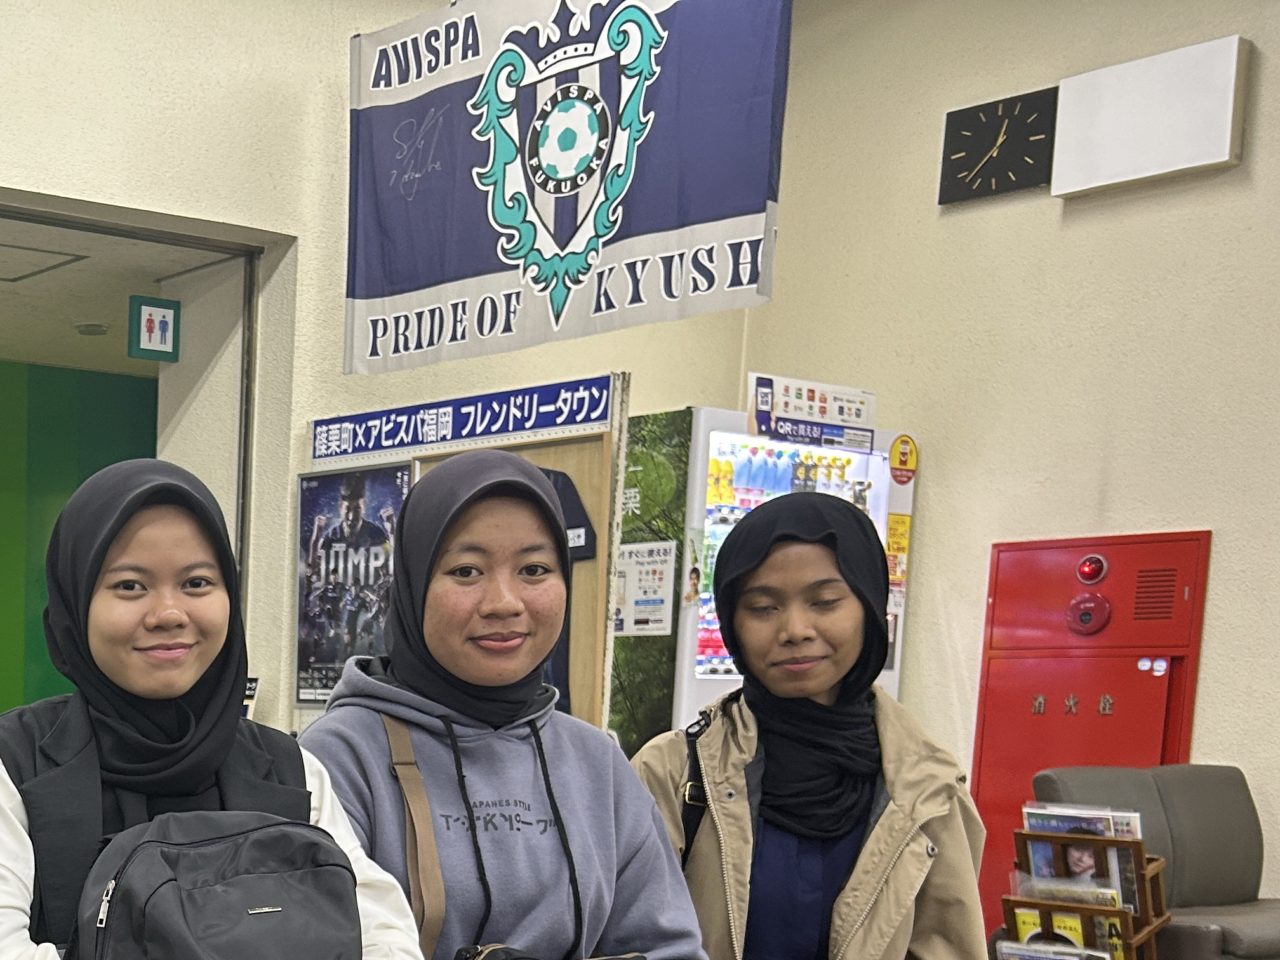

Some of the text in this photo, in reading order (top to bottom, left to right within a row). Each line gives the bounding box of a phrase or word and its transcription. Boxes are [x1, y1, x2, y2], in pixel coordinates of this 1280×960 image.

[370, 14, 481, 90] AVISPA
[533, 85, 605, 131] AVISPA
[529, 138, 609, 193] FUKUOKA
[368, 300, 468, 360] PRIDE
[475, 288, 523, 340] OF
[460, 385, 608, 437] フレンドリータウン
[1031, 693, 1114, 715] 消火栓
[471, 799, 511, 809] APANES
